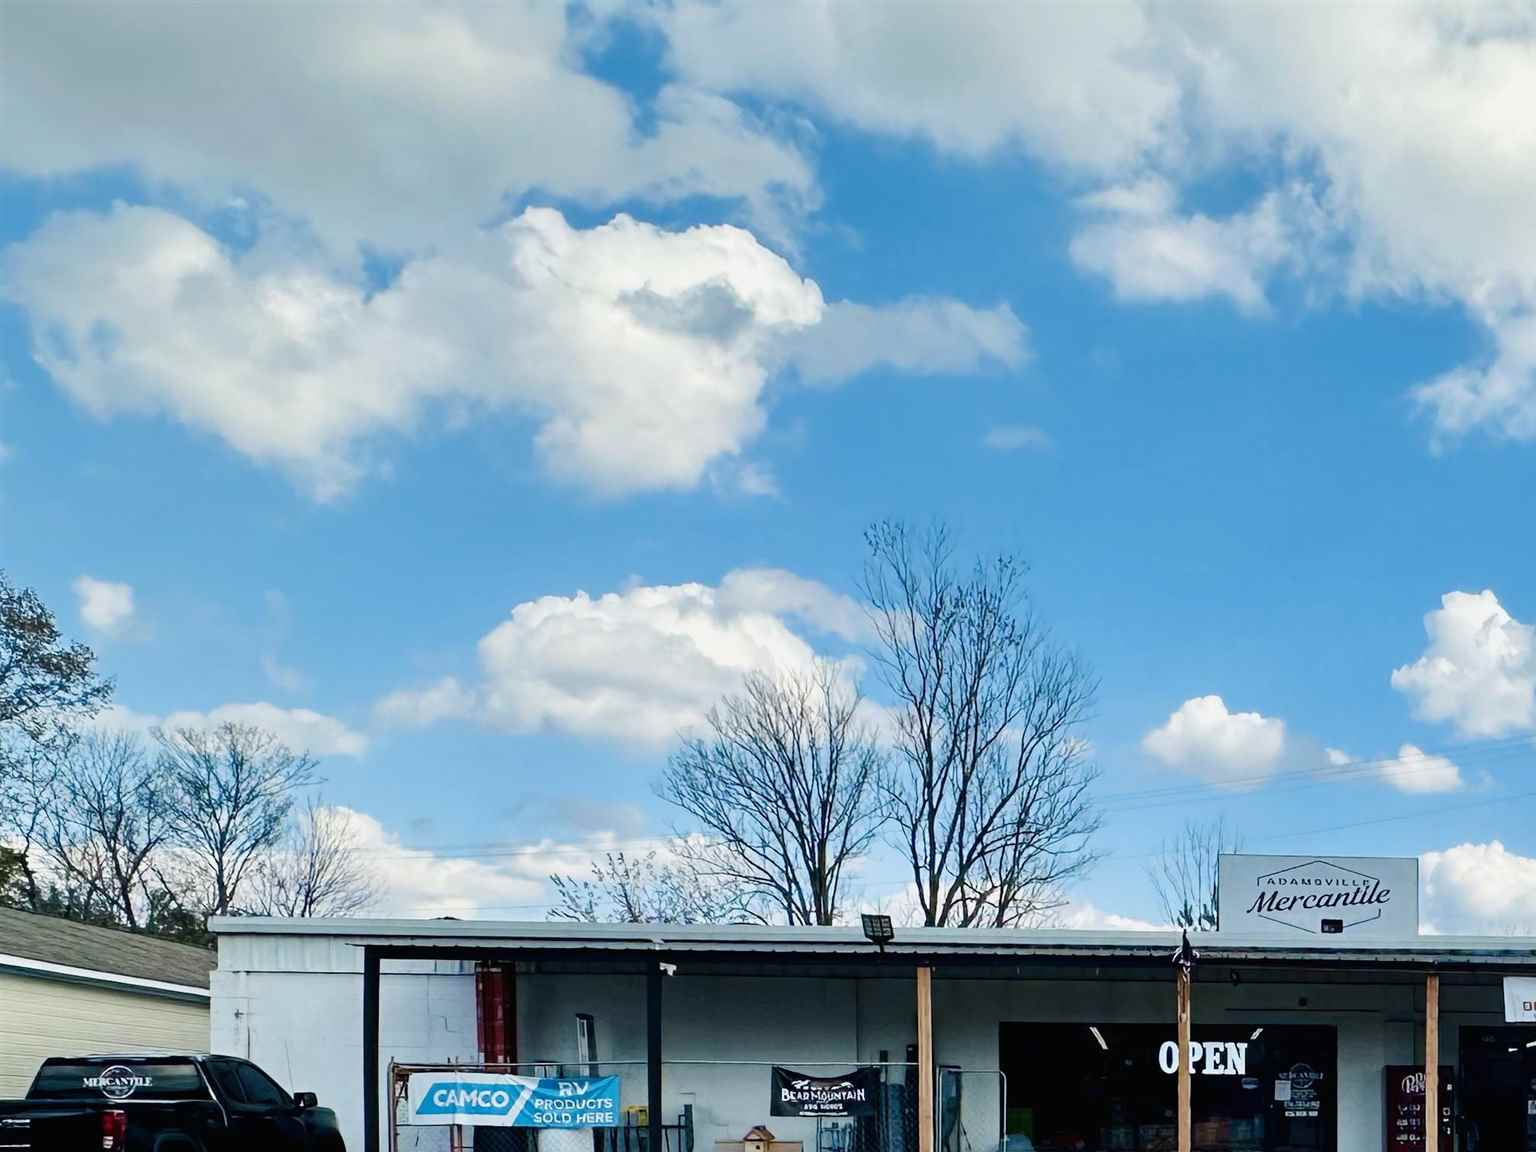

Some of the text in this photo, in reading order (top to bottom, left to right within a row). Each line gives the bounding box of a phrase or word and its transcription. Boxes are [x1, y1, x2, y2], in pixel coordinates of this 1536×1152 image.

[1246, 885, 1391, 914] Mercantile
[1158, 1040, 1249, 1076] OPEN
[82, 1077, 153, 1088] MERCANTILE
[558, 1081, 589, 1097] RV
[432, 1088, 510, 1109] CAMCO
[810, 1087, 866, 1102] MOUNTAIN
[533, 1098, 614, 1110] PRODUCTS
[532, 1112, 614, 1124] SOLD HERE
